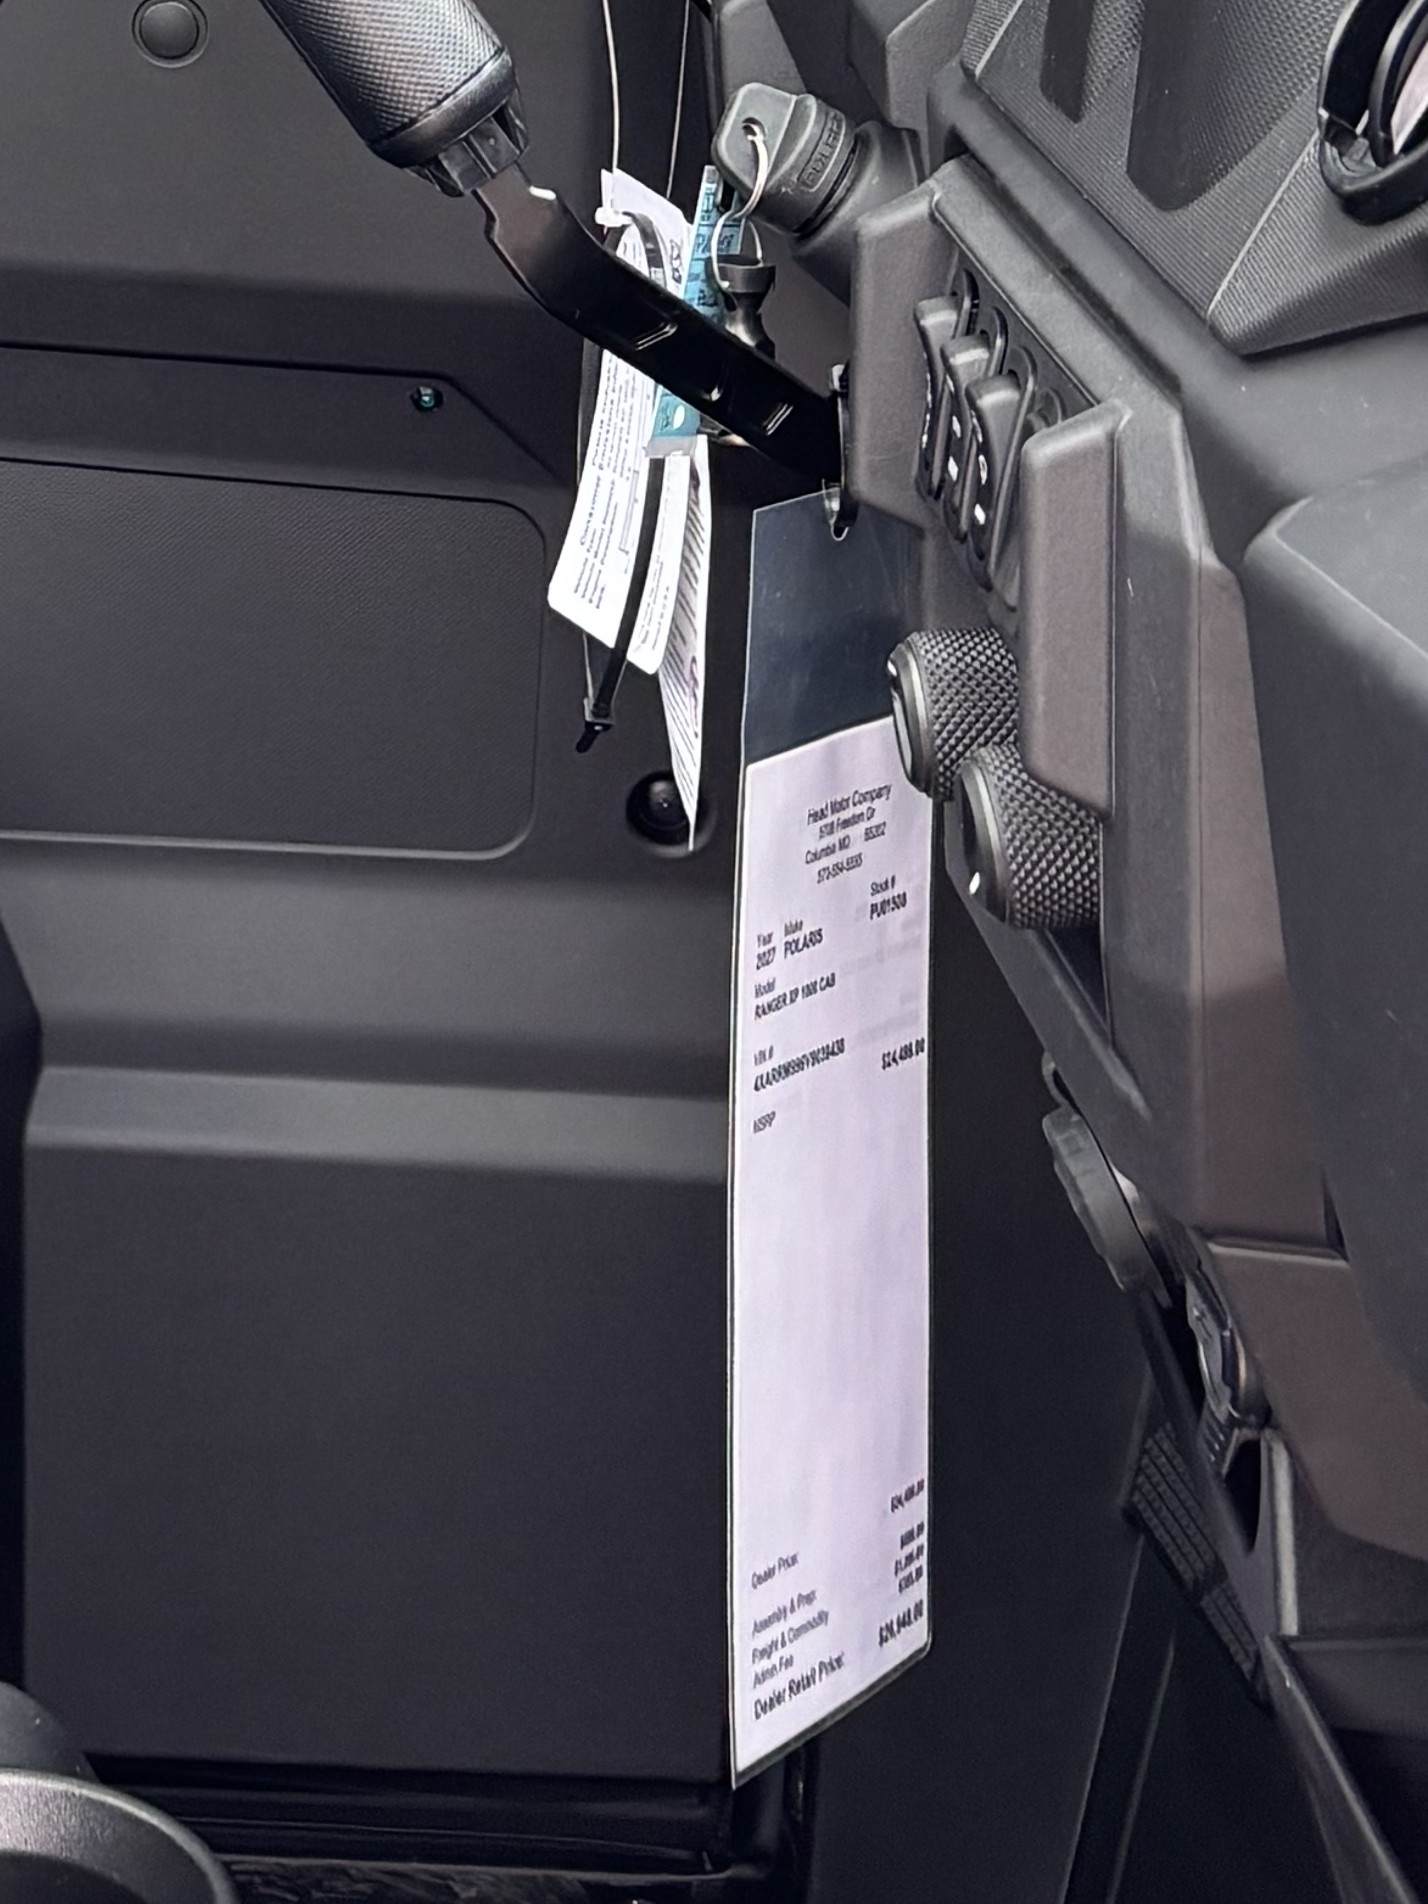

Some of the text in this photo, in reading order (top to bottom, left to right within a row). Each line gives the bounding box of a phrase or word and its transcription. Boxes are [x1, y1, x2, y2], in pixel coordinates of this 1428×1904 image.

[830, 796, 851, 815] Motor
[852, 784, 892, 807] Company
[870, 876, 889, 896] Stock
[784, 927, 823, 959] POLARIS
[754, 991, 787, 1021] RANGER
[819, 972, 836, 992] CAB
[751, 1561, 776, 1589] Dealer
[754, 1685, 786, 1720] Dealer
